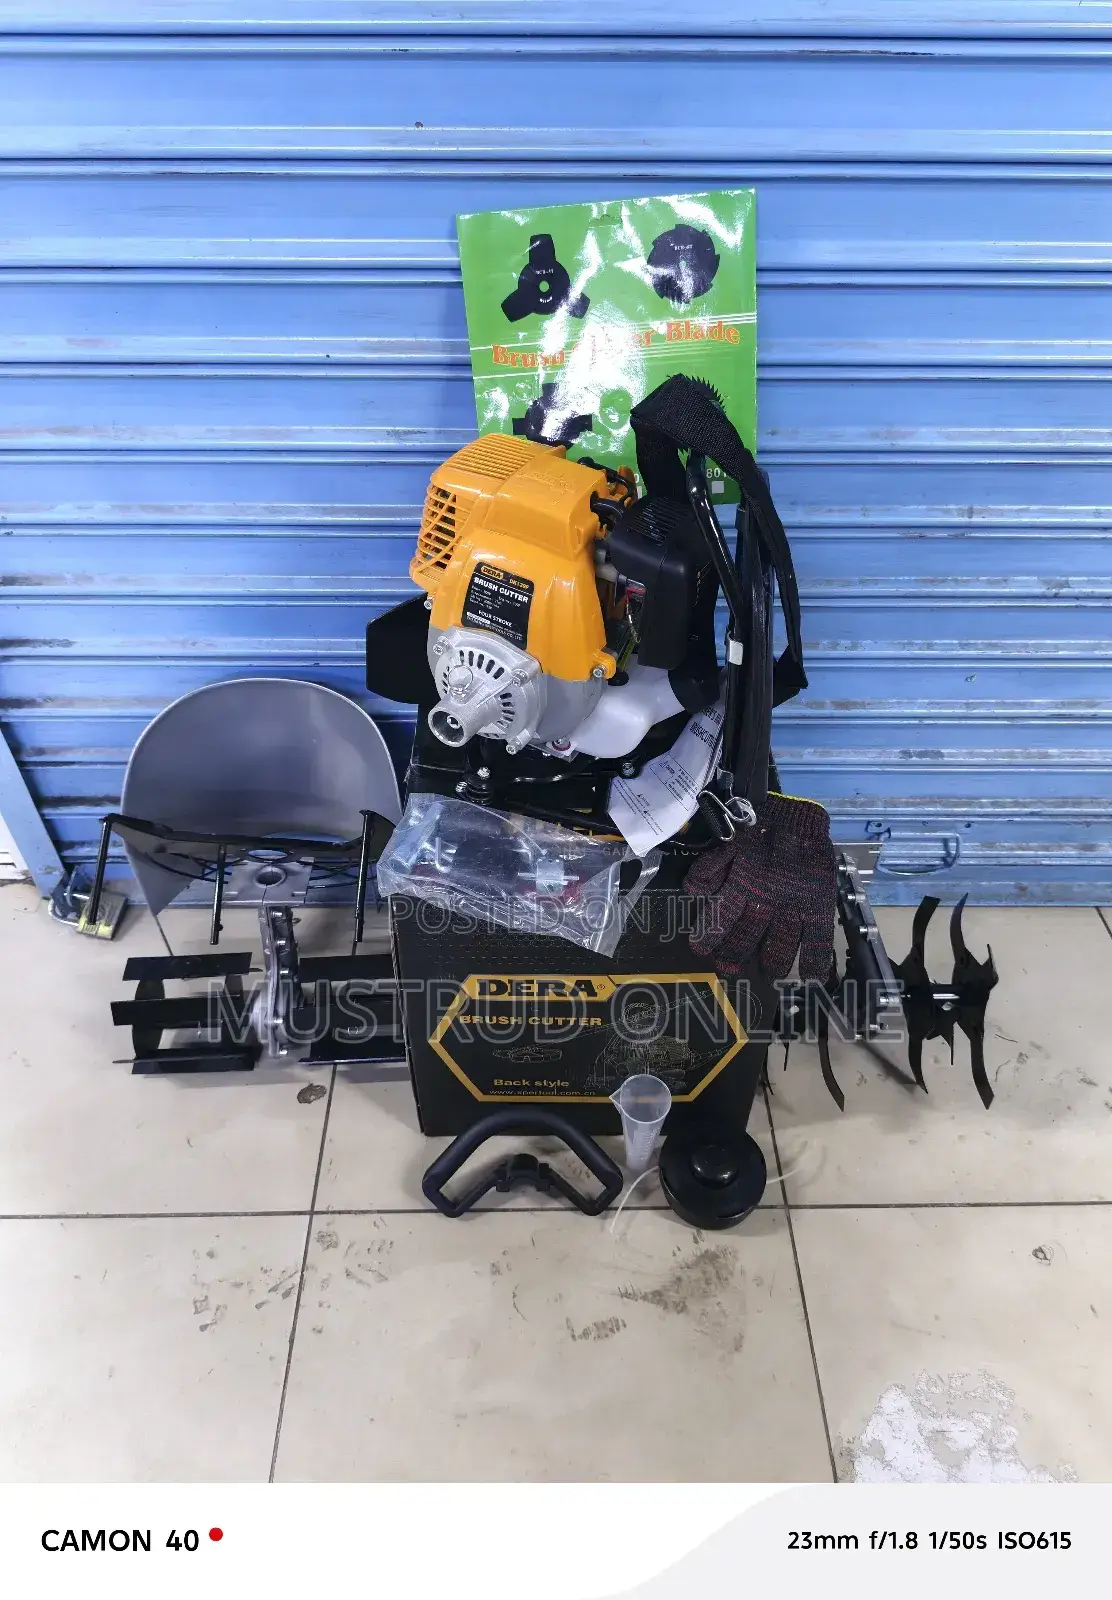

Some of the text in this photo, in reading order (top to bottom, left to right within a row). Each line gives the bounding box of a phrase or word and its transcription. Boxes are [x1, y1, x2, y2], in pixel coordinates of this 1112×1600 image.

[665, 321, 740, 344] Blade
[474, 577, 499, 591] BRUSH
[499, 588, 529, 603] CUTTER
[459, 1015, 602, 1026] BRUSH CUTTER
[493, 1079, 570, 1088] Back style
